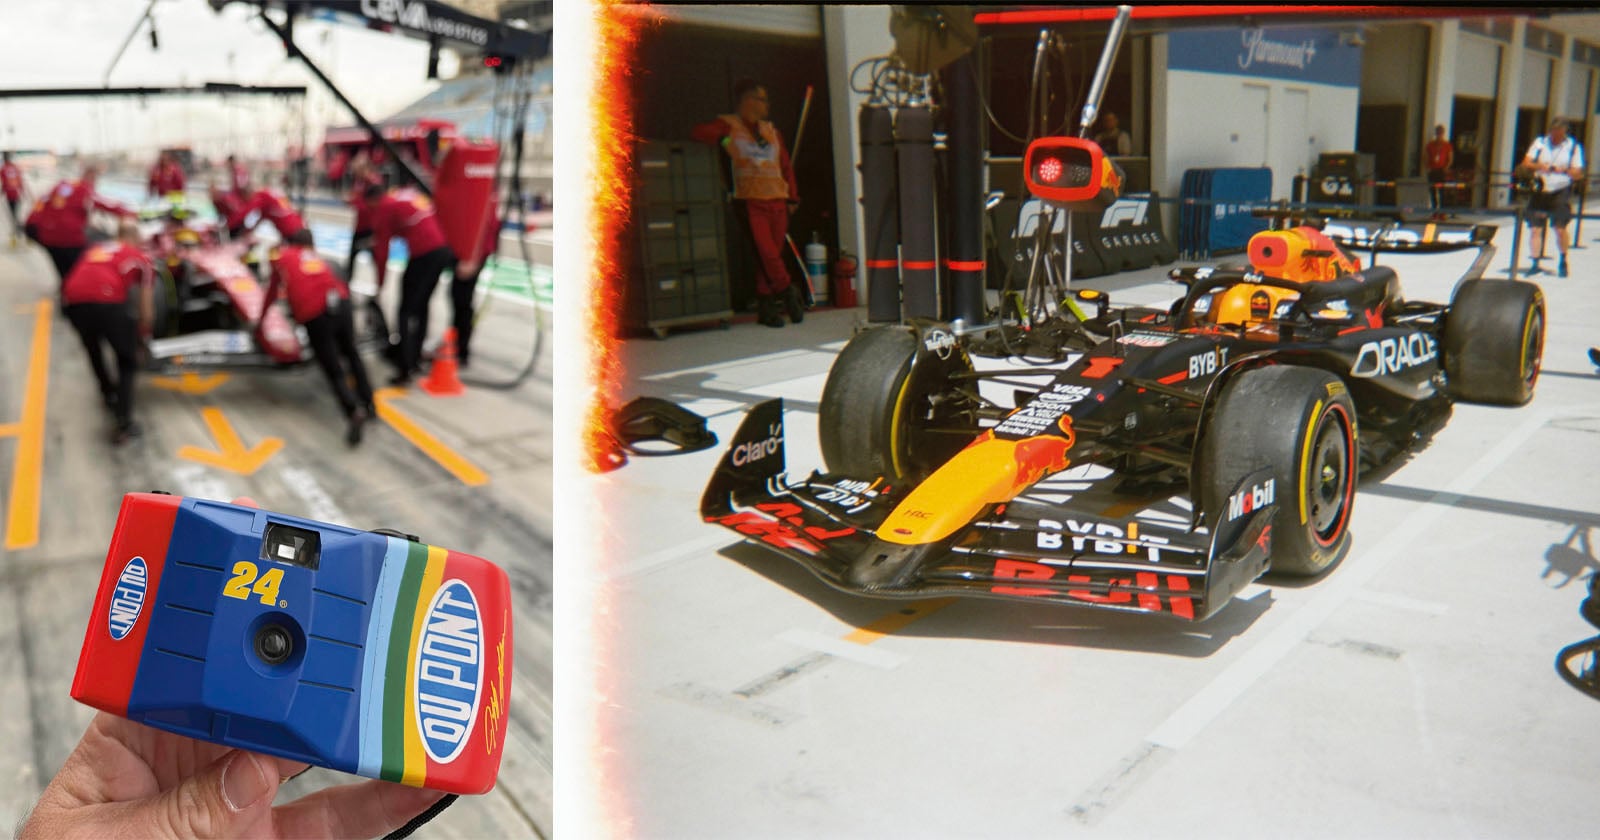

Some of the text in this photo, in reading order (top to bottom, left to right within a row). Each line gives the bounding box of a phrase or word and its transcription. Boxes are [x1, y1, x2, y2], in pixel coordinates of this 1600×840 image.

[1101, 232, 1161, 249] GARAGE
[1189, 345, 1229, 379] BYBIT
[1350, 332, 1437, 377] ORACLE
[1053, 384, 1091, 395] VISA
[732, 436, 778, 467] Claro
[1228, 478, 1275, 522] Mobil
[1037, 519, 1169, 562] BYBIT
[222, 561, 285, 607] 24
